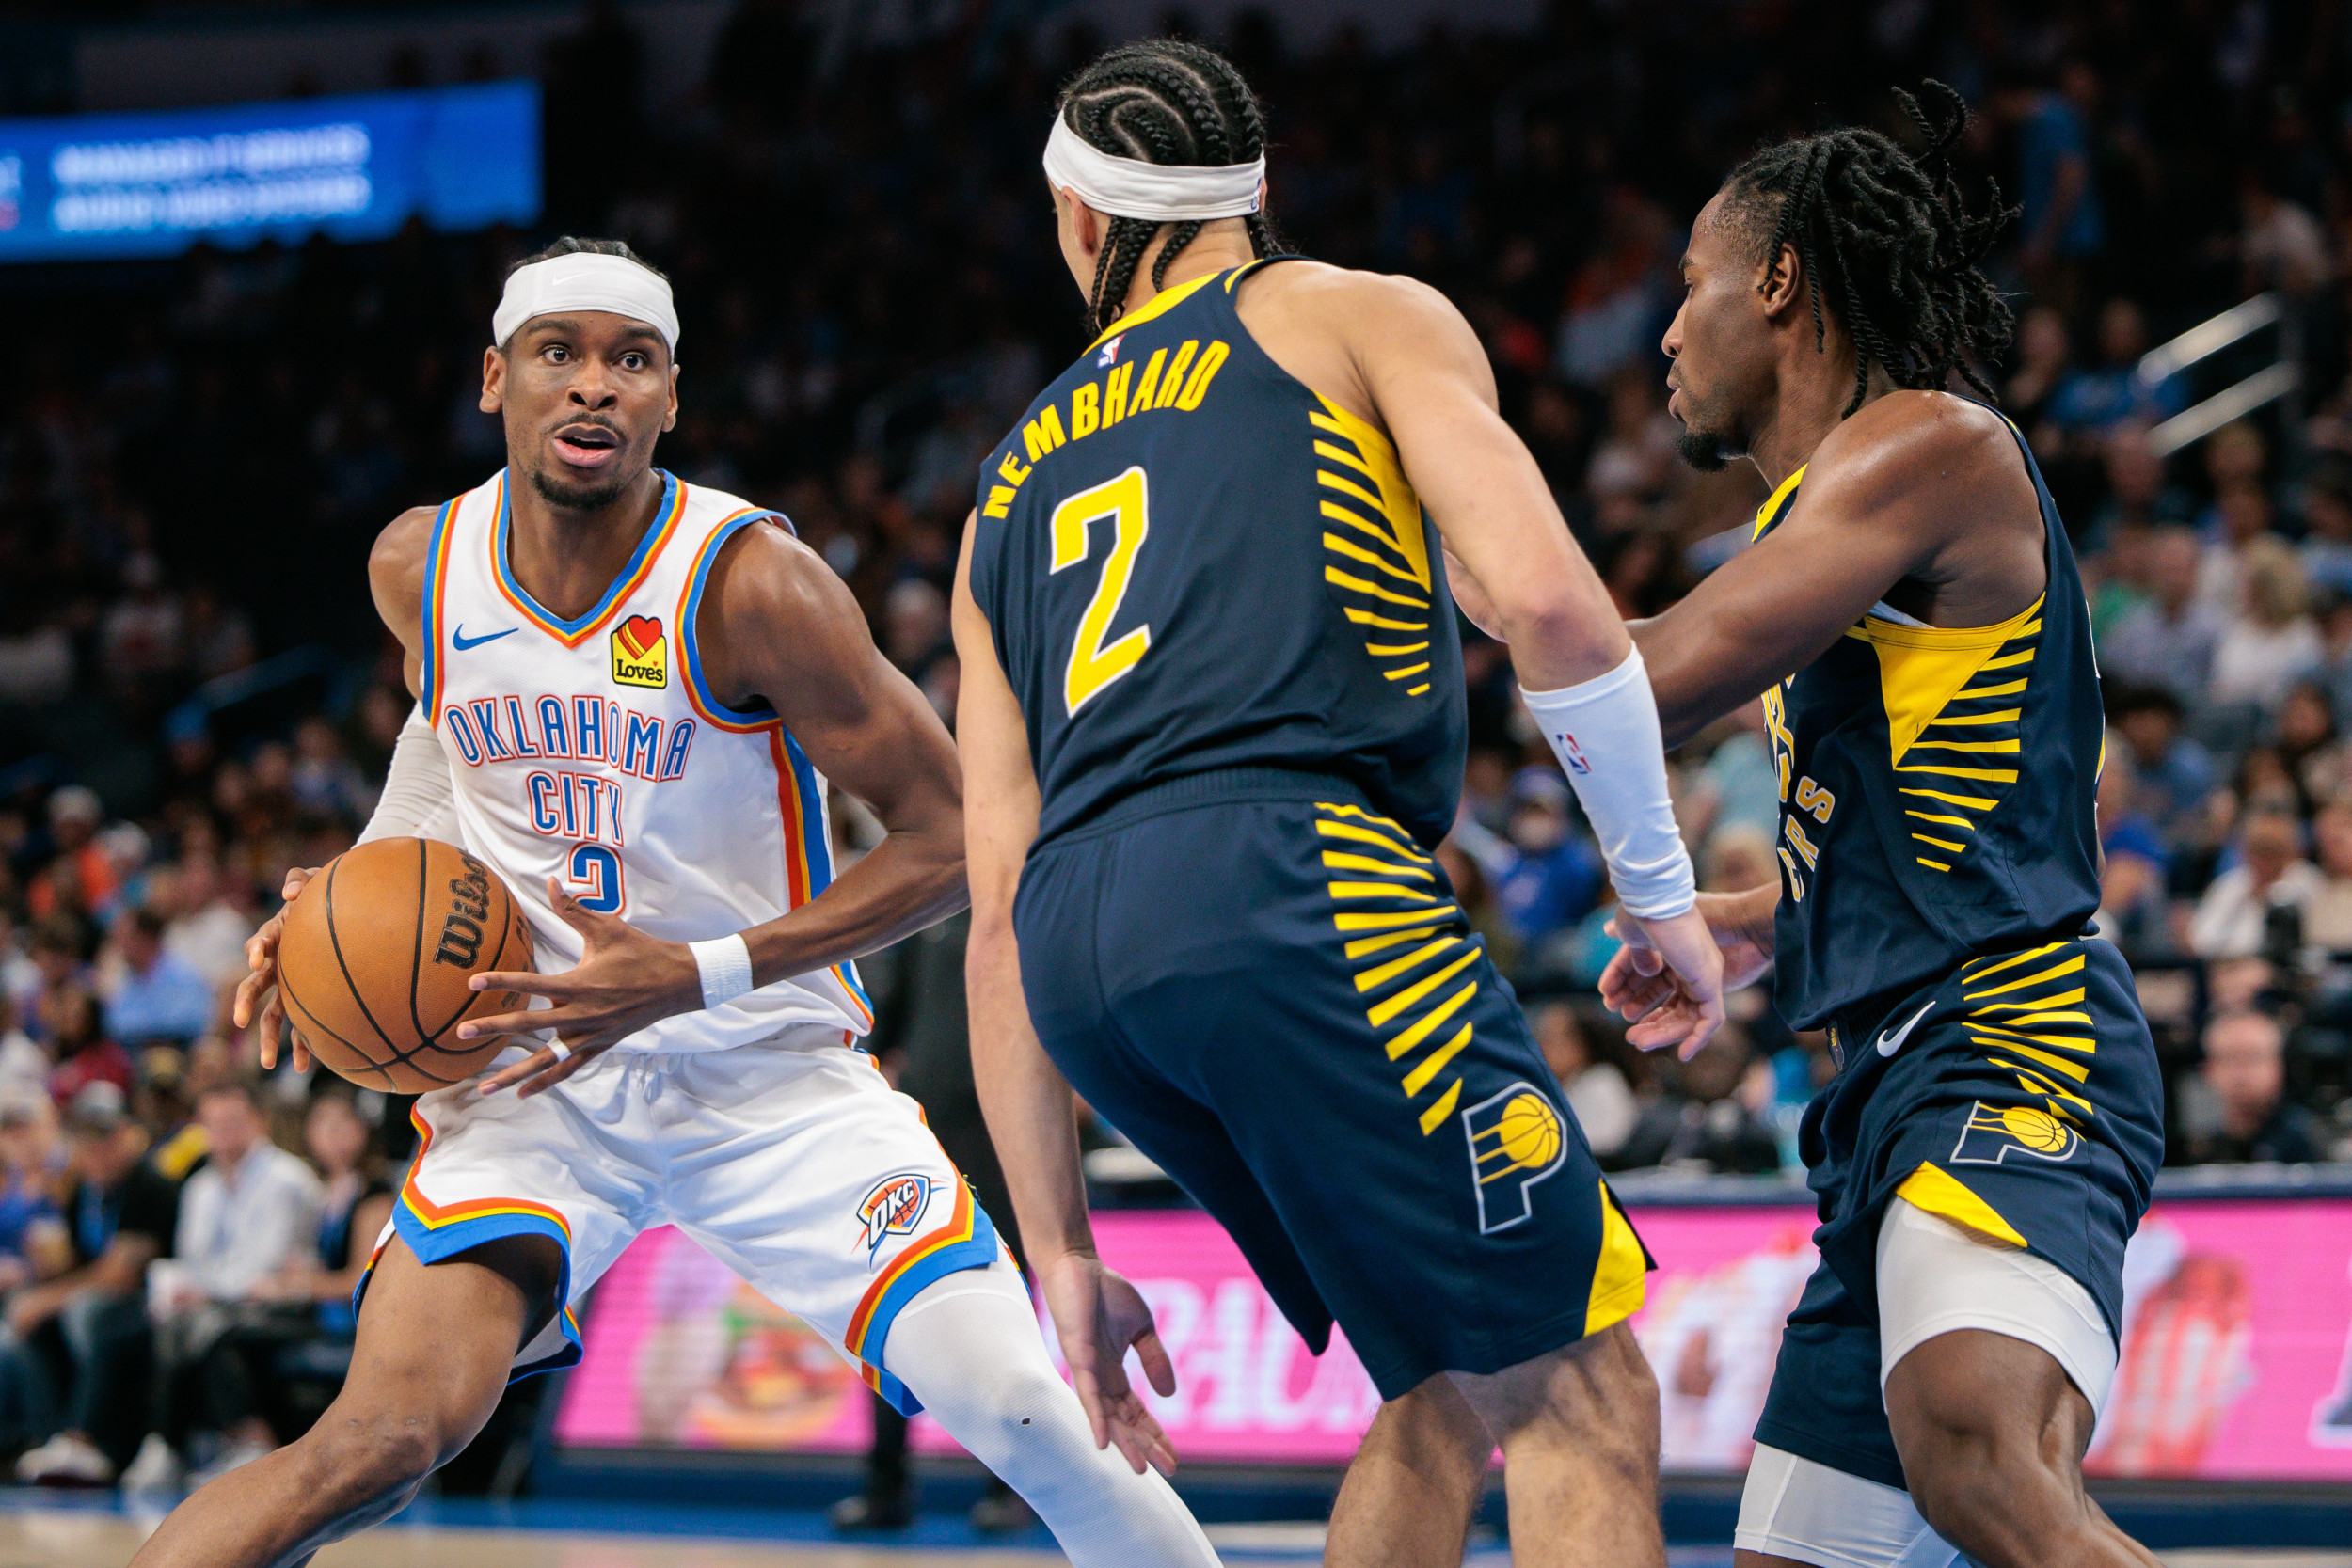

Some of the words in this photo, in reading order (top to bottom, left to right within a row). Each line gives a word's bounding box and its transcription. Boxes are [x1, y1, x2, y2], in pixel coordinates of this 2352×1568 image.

[982, 339, 1230, 519] NEMBHARD
[1049, 465, 1152, 719] 2
[444, 694, 696, 783] OKLAHOMA
[526, 771, 624, 847] CITY
[433, 847, 490, 970] Wilso
[868, 1180, 915, 1249] OKC
